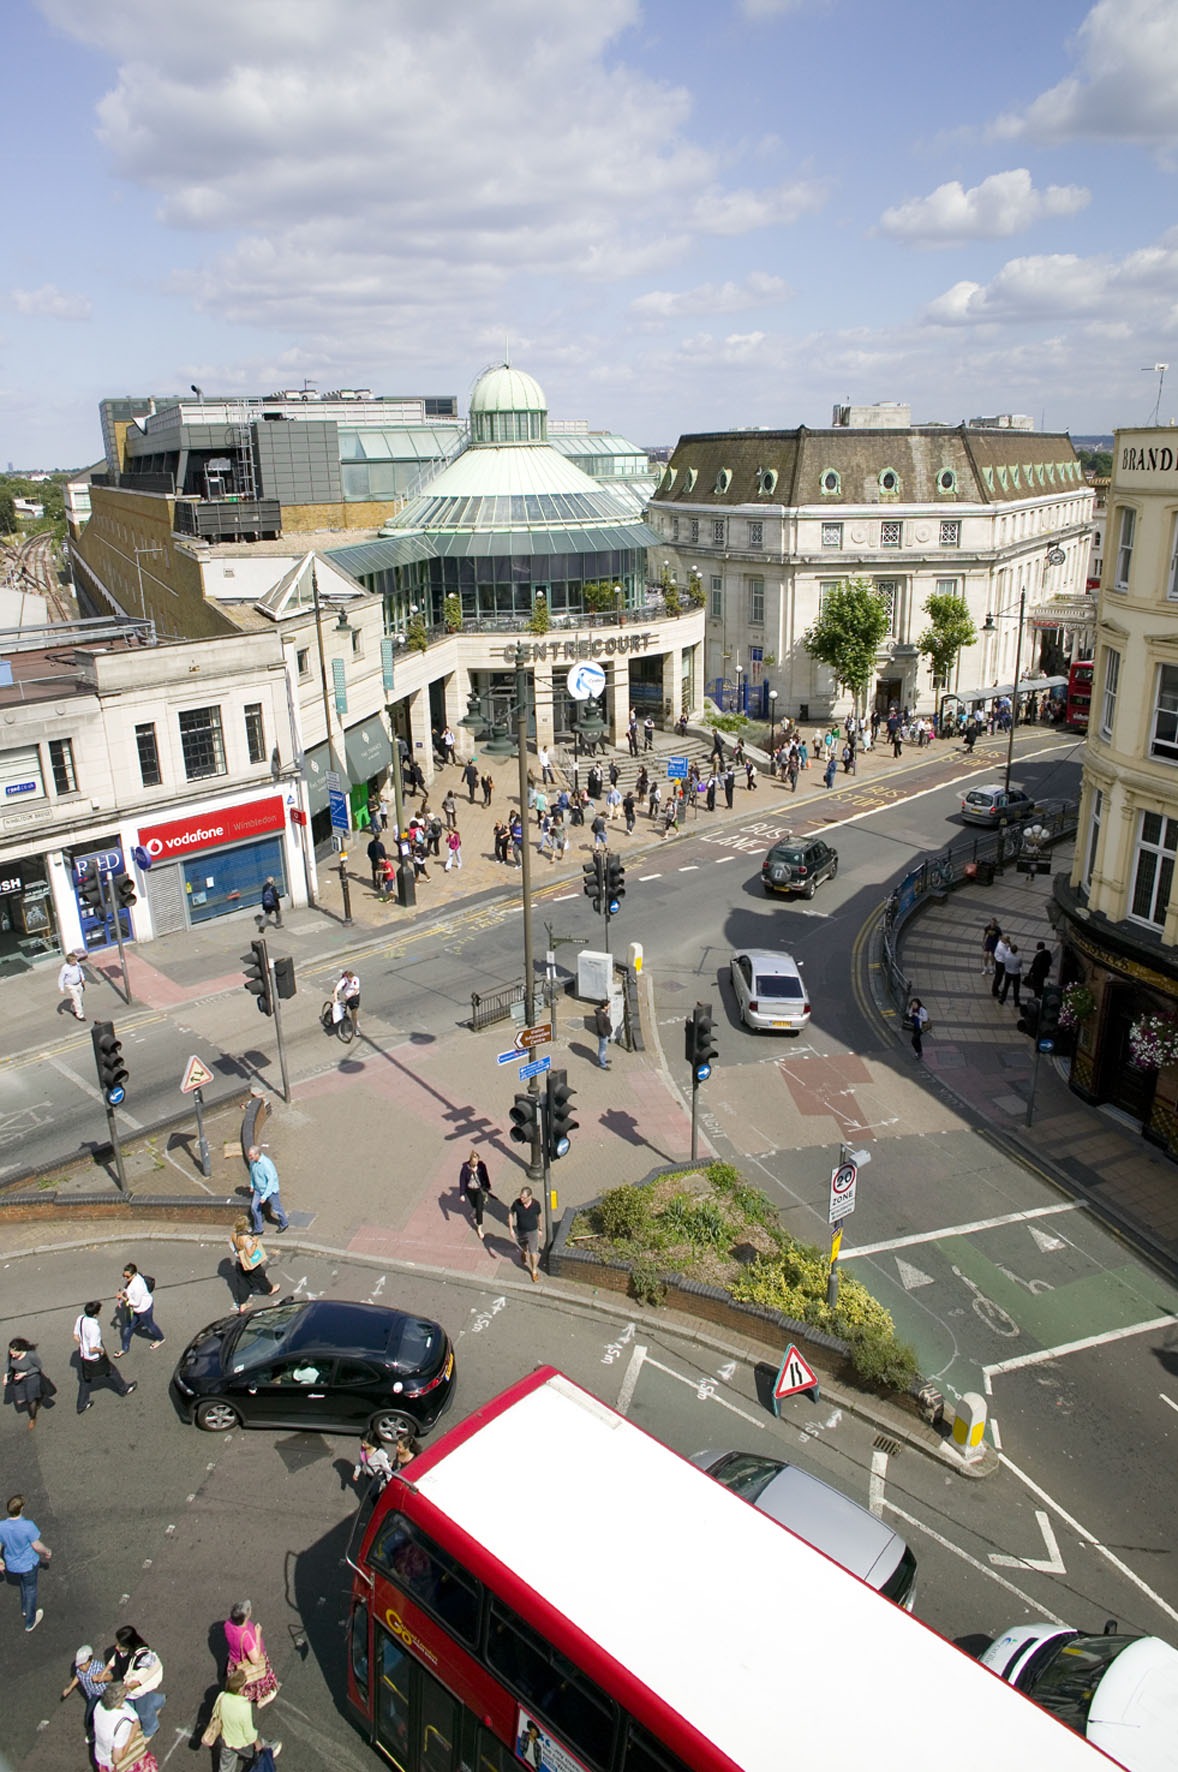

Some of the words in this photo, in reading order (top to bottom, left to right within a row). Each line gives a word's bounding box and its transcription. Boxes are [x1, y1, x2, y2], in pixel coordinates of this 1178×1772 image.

[1122, 447, 1178, 472] BRAND
[828, 792, 885, 807] STOP
[861, 785, 907, 799] BUS
[165, 826, 224, 848] vodafone
[233, 814, 278, 832] Wimbledon
[739, 822, 793, 840] BUS
[699, 830, 769, 853] LANE
[76, 852, 120, 877] RED
[0, 877, 22, 892] SH
[698, 1112, 728, 1139] RIGHT
[836, 1171, 852, 1188] 20
[832, 1190, 854, 1206] ZONE
[385, 1608, 413, 1646] Go
